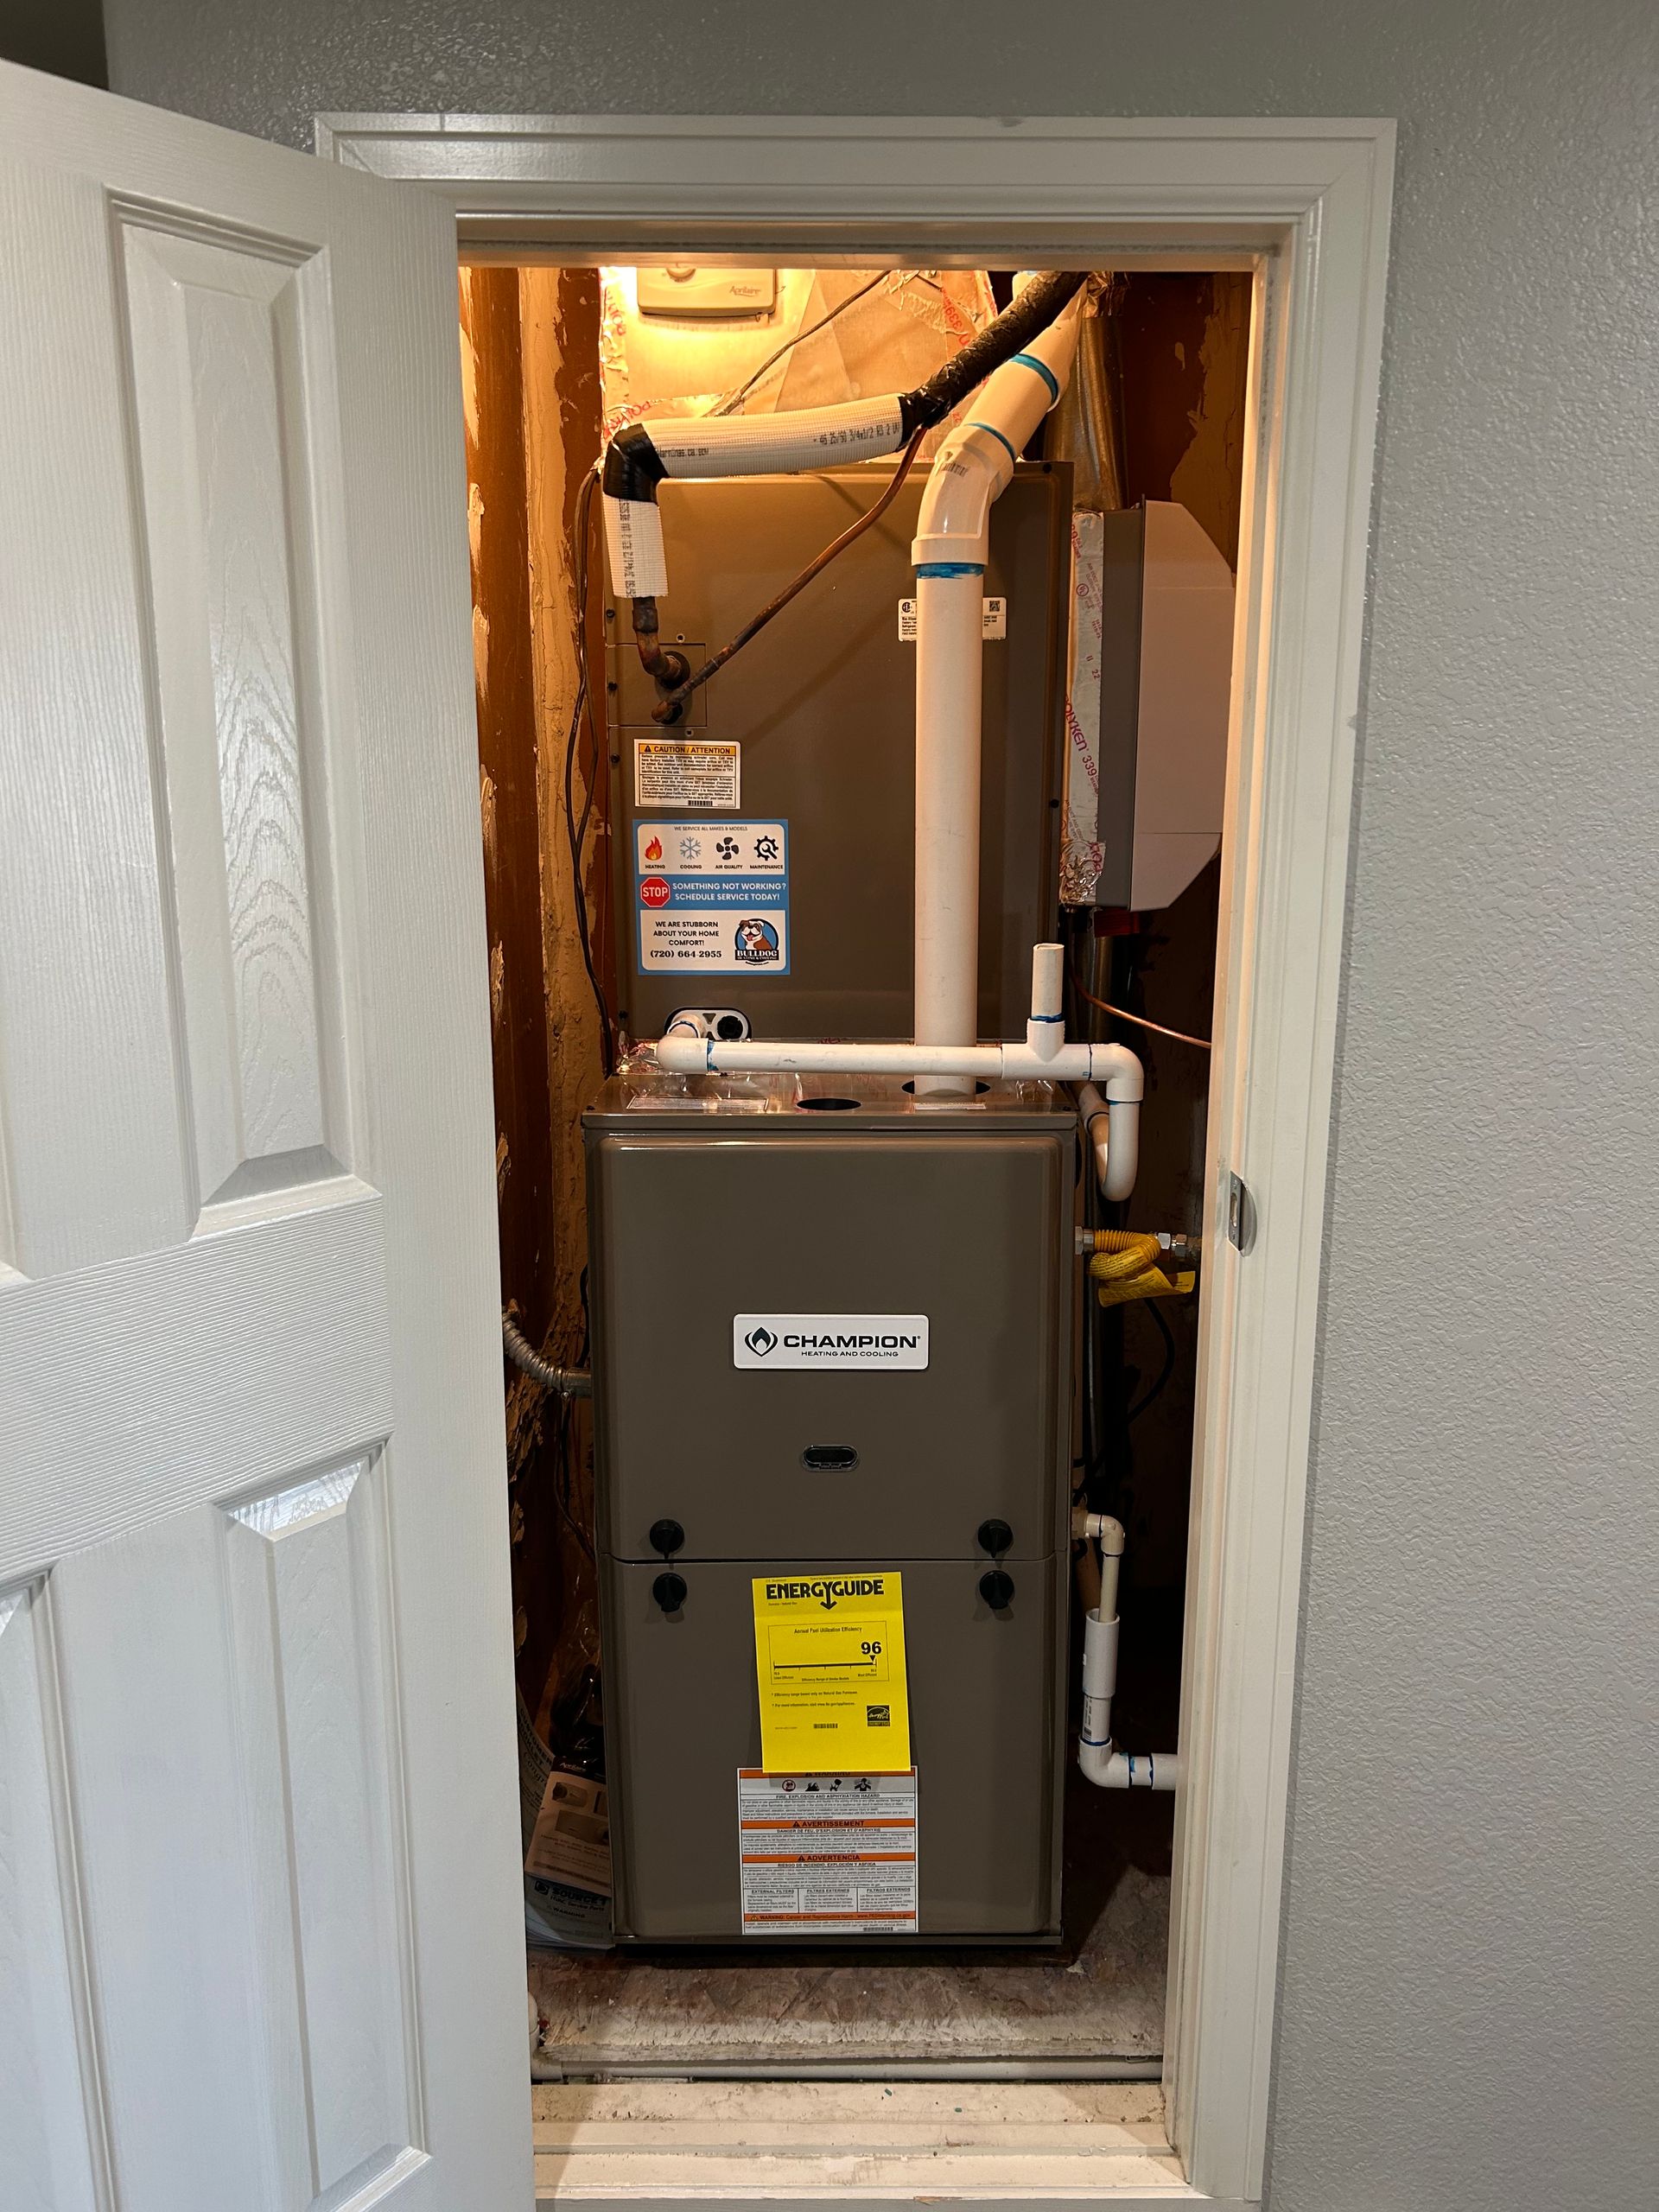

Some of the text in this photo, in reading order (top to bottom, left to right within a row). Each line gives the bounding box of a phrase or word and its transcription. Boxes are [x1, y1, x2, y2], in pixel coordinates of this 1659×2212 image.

[1092, 669, 1101, 678] 22
[1082, 755, 1098, 776] 339
[642, 887, 668, 898] STOP
[650, 950, 722, 958] (720) 664-2955
[784, 1335, 917, 1349] CHAMPION
[766, 1580, 884, 1599] ENERGYGUIDE
[861, 1641, 881, 1655] 96
